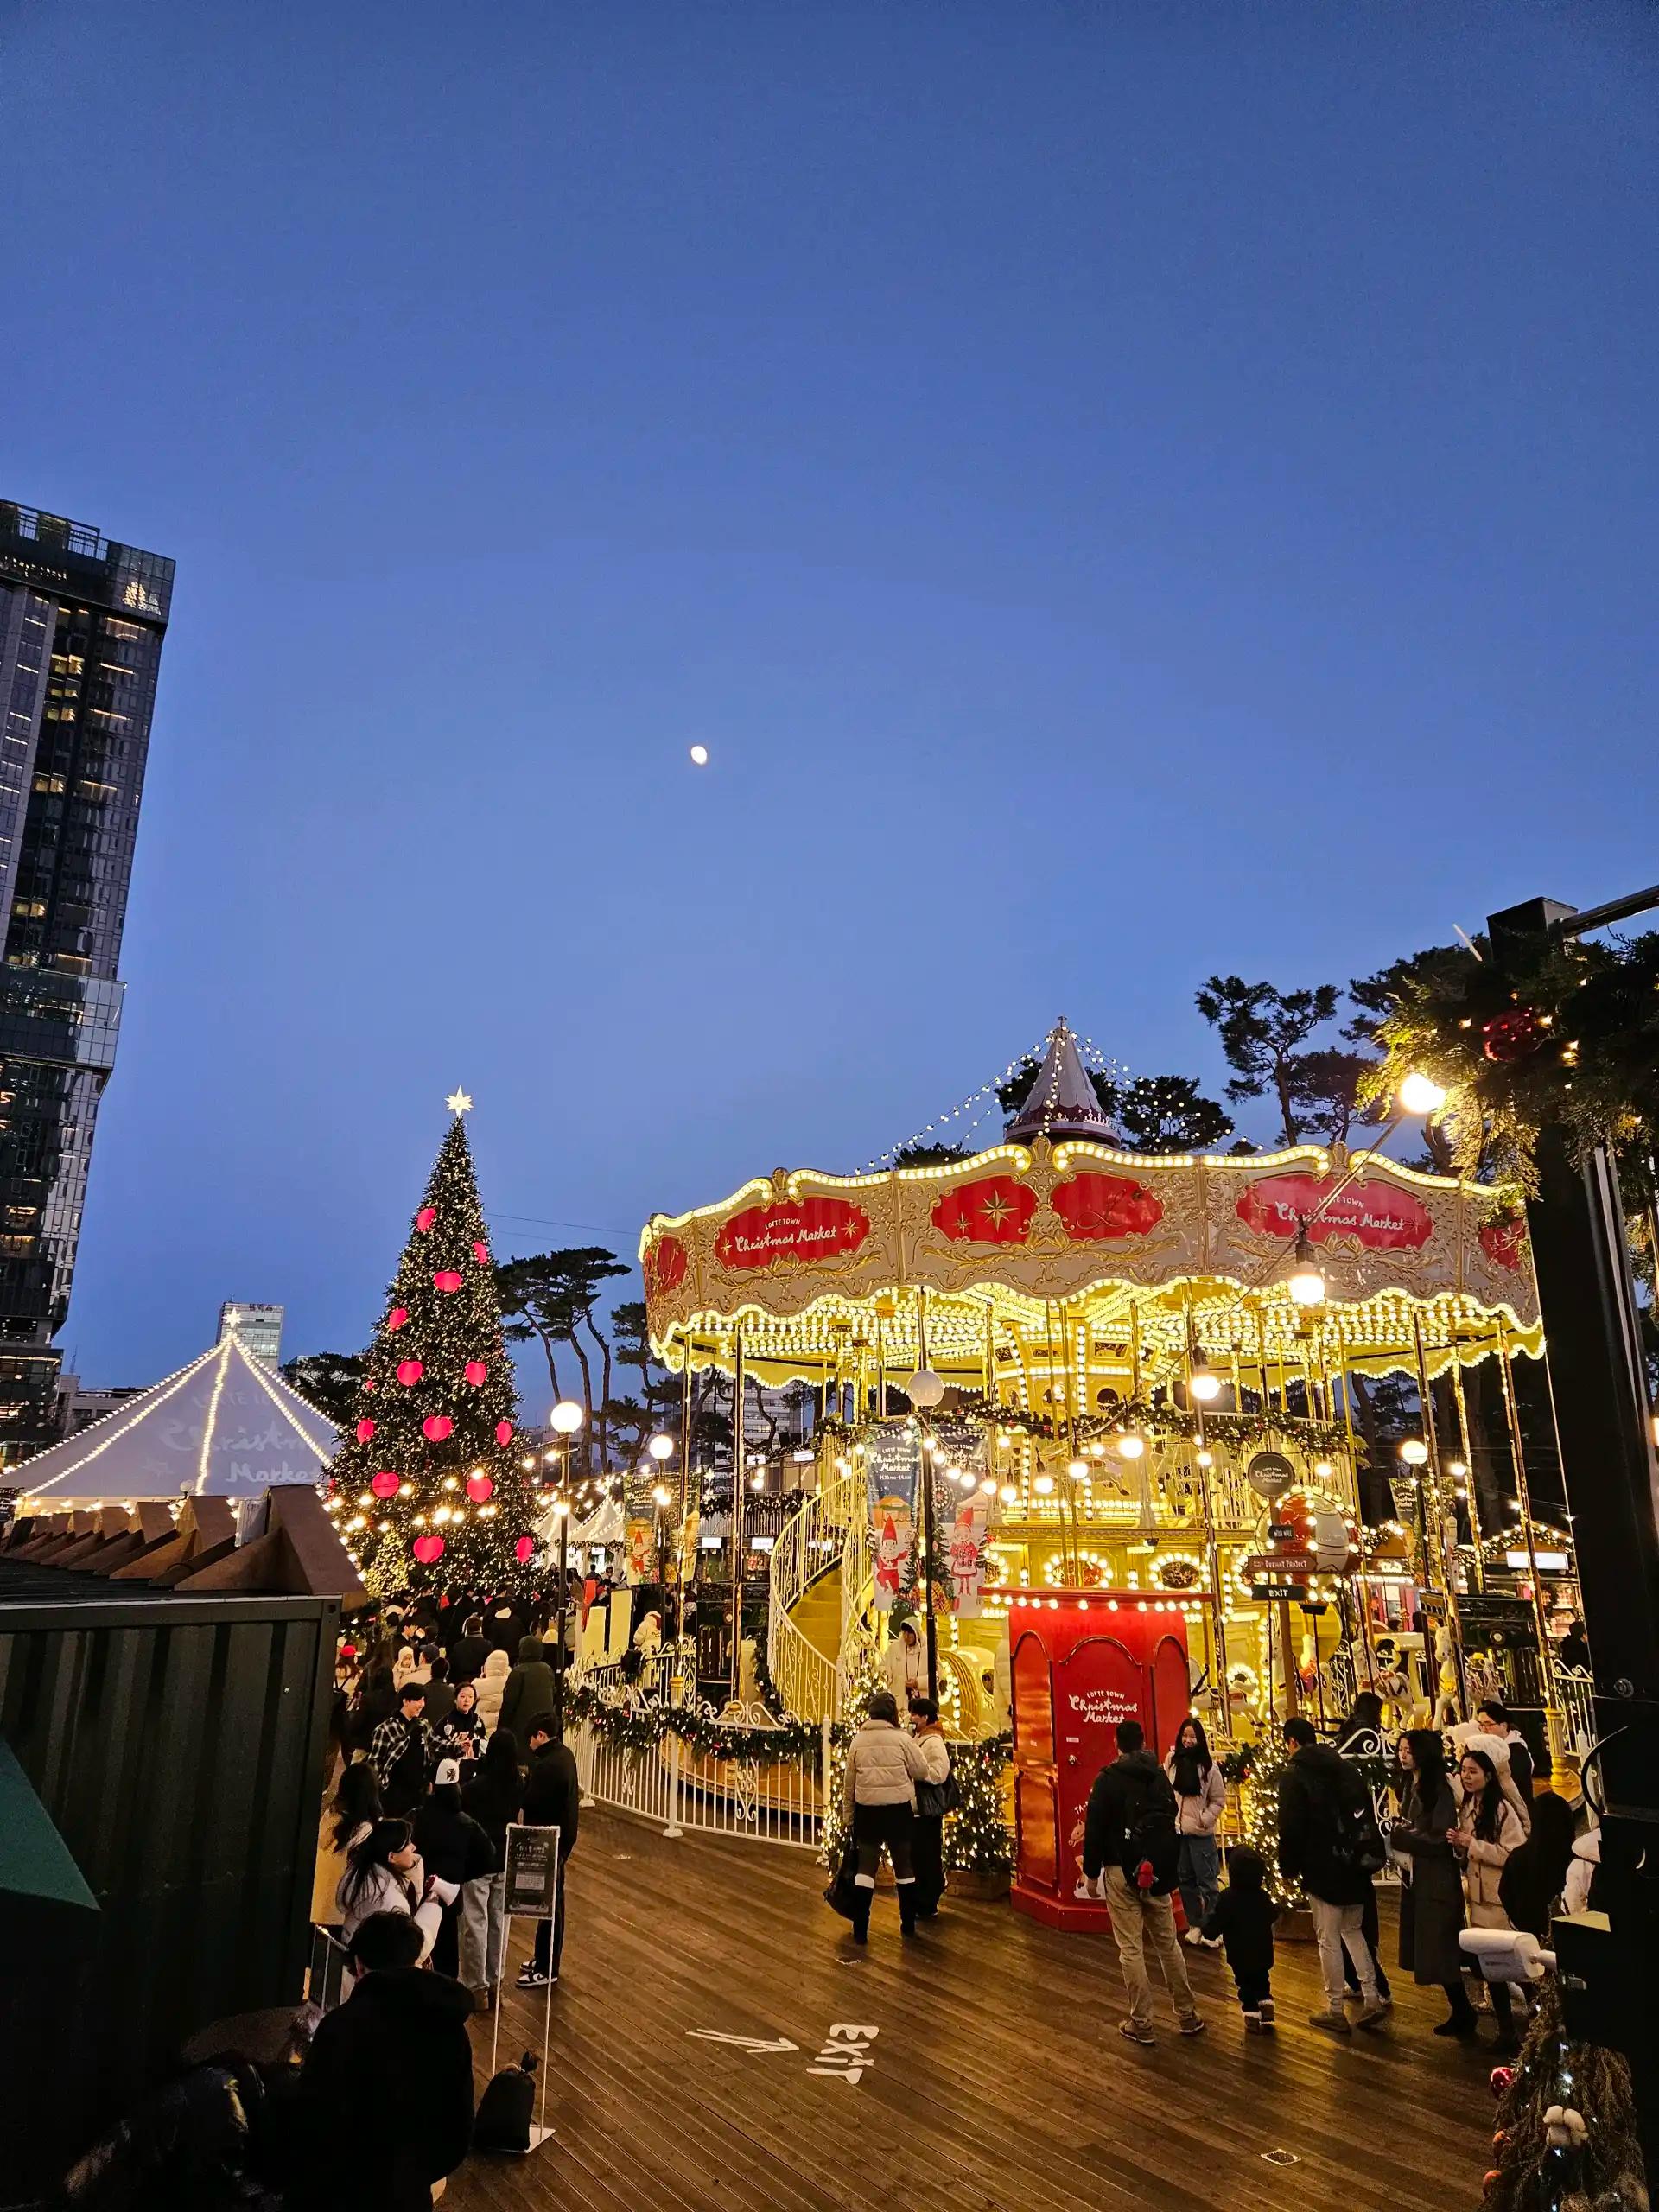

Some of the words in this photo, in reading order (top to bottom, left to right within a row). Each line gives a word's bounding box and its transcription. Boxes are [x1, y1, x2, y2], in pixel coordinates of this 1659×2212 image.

[1343, 1197, 1364, 1209] TOWN
[765, 1218, 781, 1230] LOTTE
[1359, 1213, 1405, 1230] Market
[734, 1231, 794, 1252] Christmas
[796, 1225, 836, 1243] Market
[868, 1452, 919, 1463] Christmas
[880, 1462, 911, 1471] Market
[1106, 1691, 1124, 1700] TOWN
[1068, 1694, 1138, 1713] Christmas
[1083, 1711, 1125, 1724] Market
